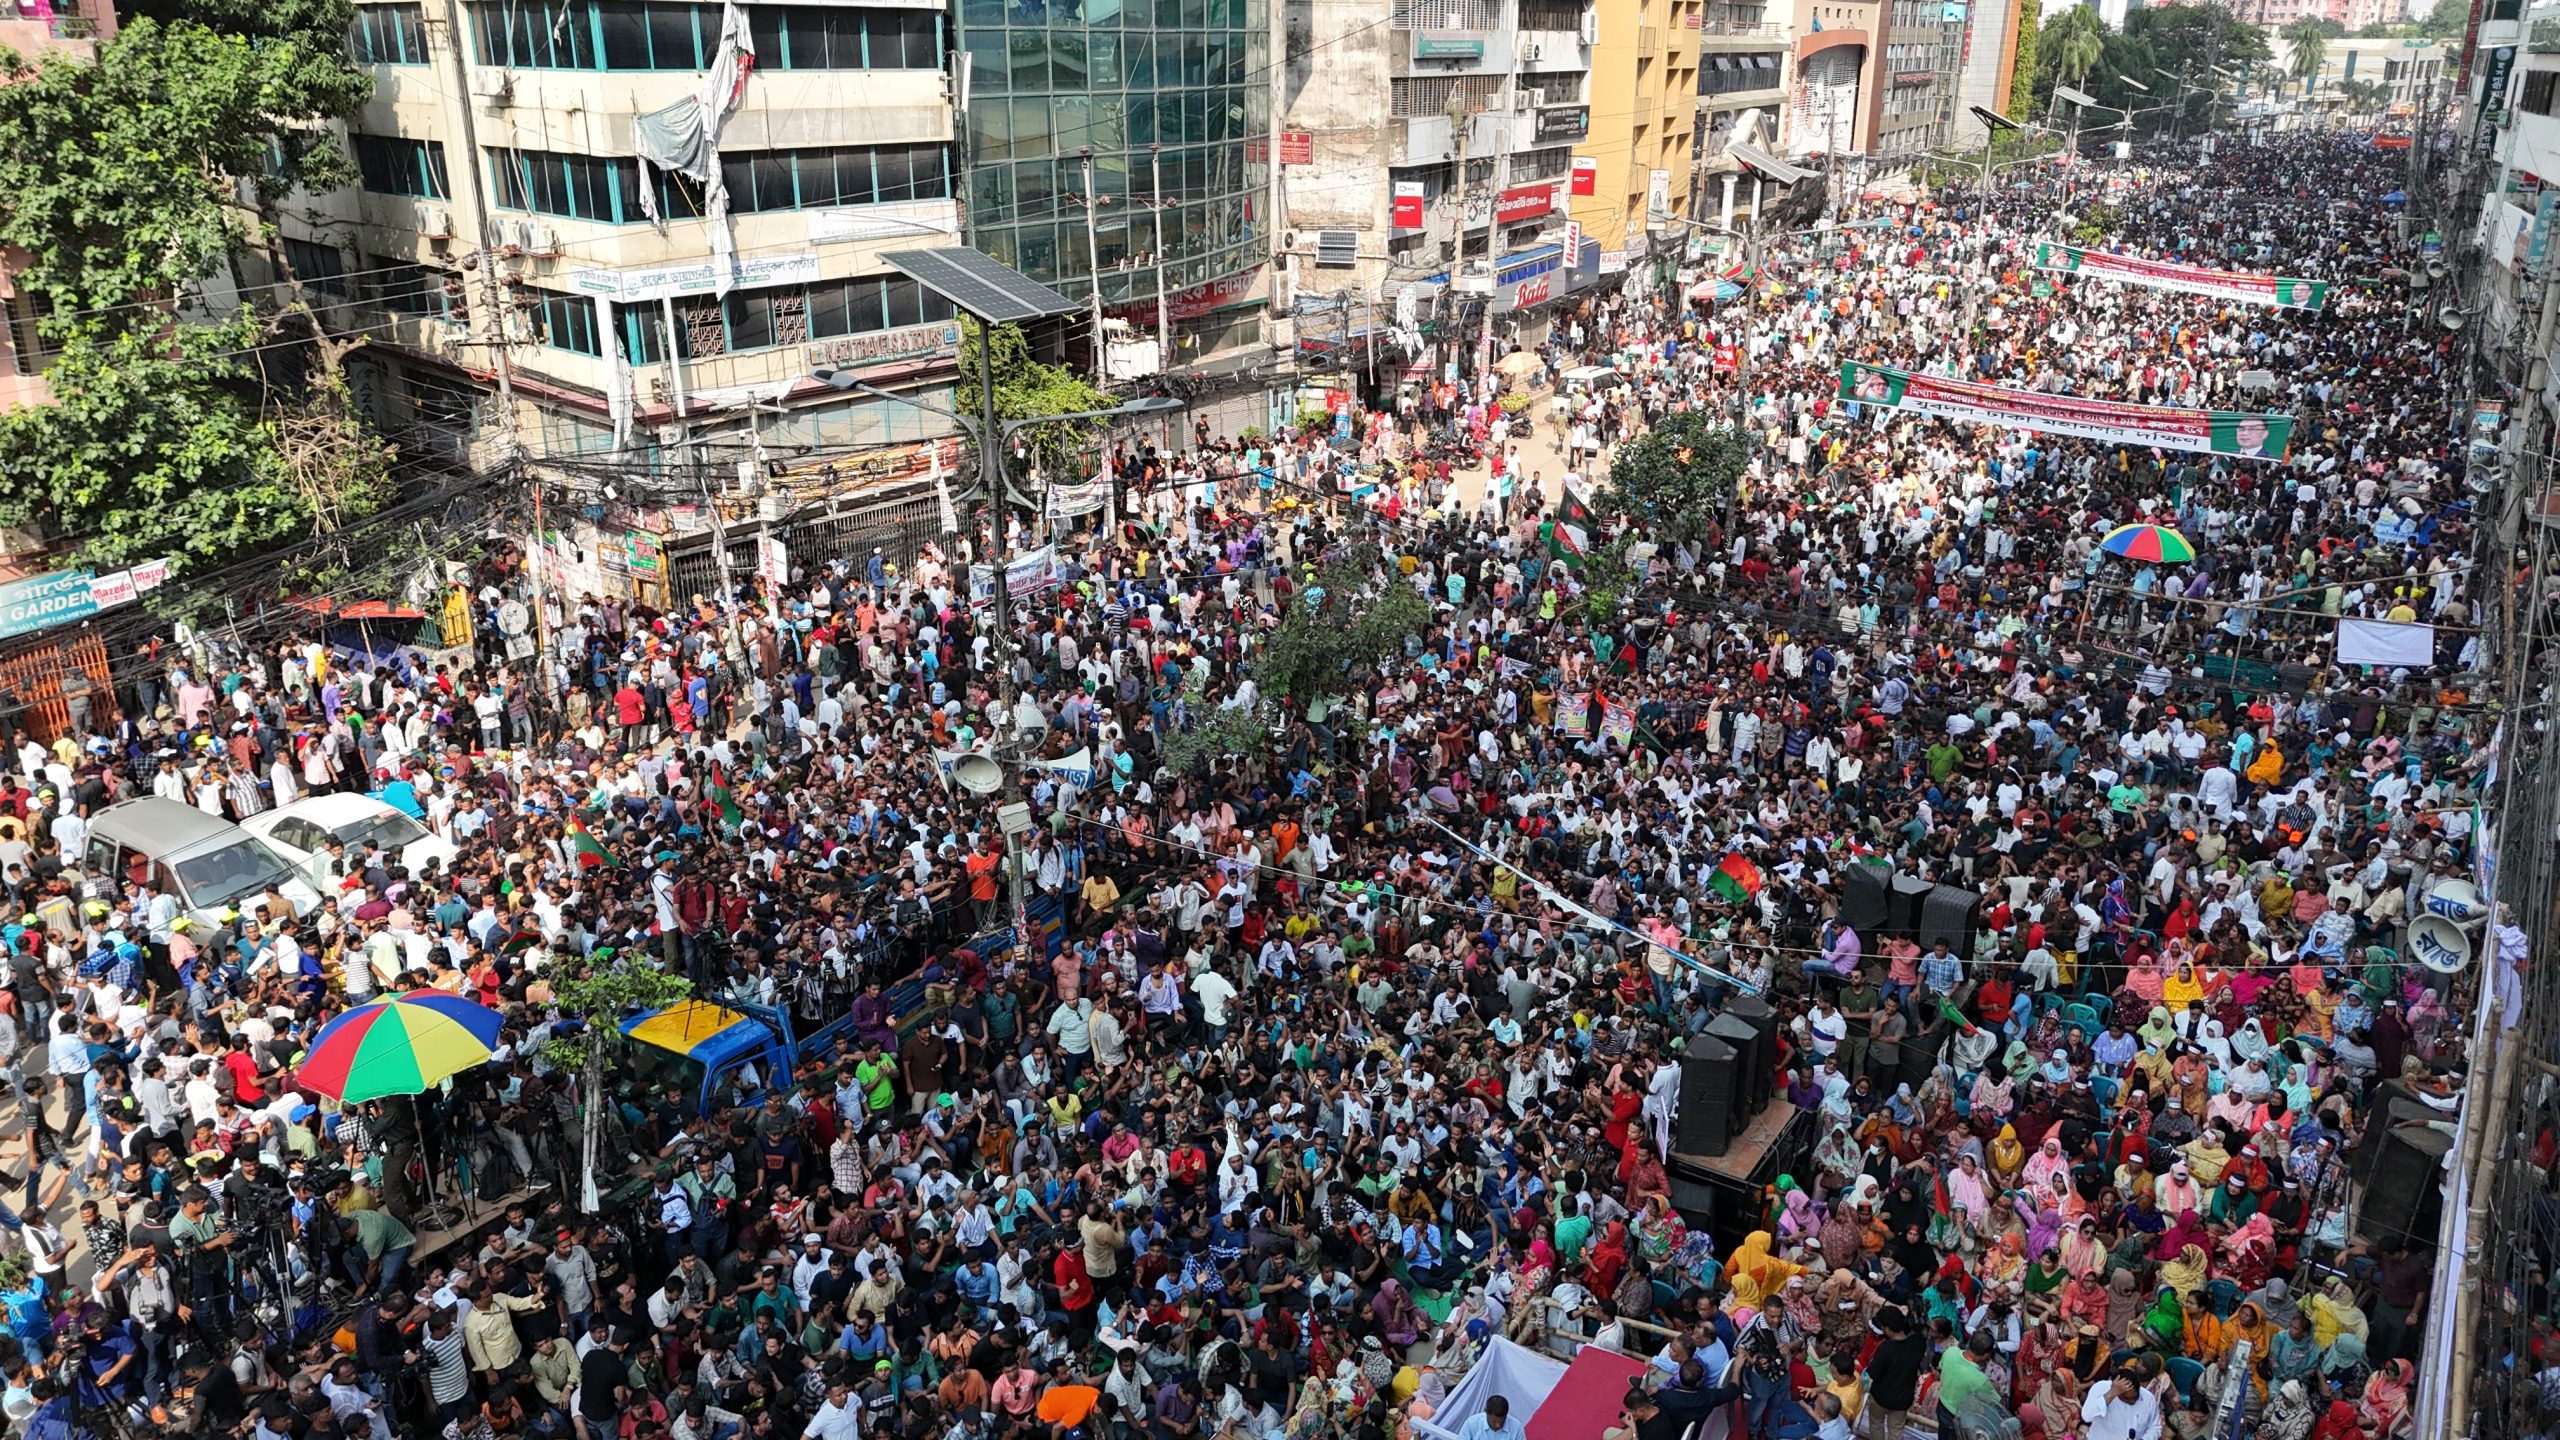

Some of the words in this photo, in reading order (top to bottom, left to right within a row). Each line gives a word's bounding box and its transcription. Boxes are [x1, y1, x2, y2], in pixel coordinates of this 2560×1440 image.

[1565, 224, 1577, 266] Bata
[1599, 253, 1624, 264] RADE
[640, 273, 667, 288] রয়েল
[670, 265, 716, 283] ডায়াগনস্টি
[745, 261, 786, 275] মেডিকেল
[787, 256, 816, 270] সেন্টার
[1212, 270, 1258, 297] লিমিটে
[1515, 279, 1550, 309] Bata
[825, 341, 852, 363] KAZI
[851, 334, 899, 358] TRAVELS
[900, 332, 910, 349] &
[909, 327, 943, 350] TOURS
[2041, 417, 2127, 437] মহানগর
[2134, 430, 2200, 446] দক্ষিণ
[2146, 420, 2181, 431] করতে
[2181, 424, 2205, 435] হবে
[11, 590, 95, 621] GARDEN
[93, 583, 132, 599] Mazeda
